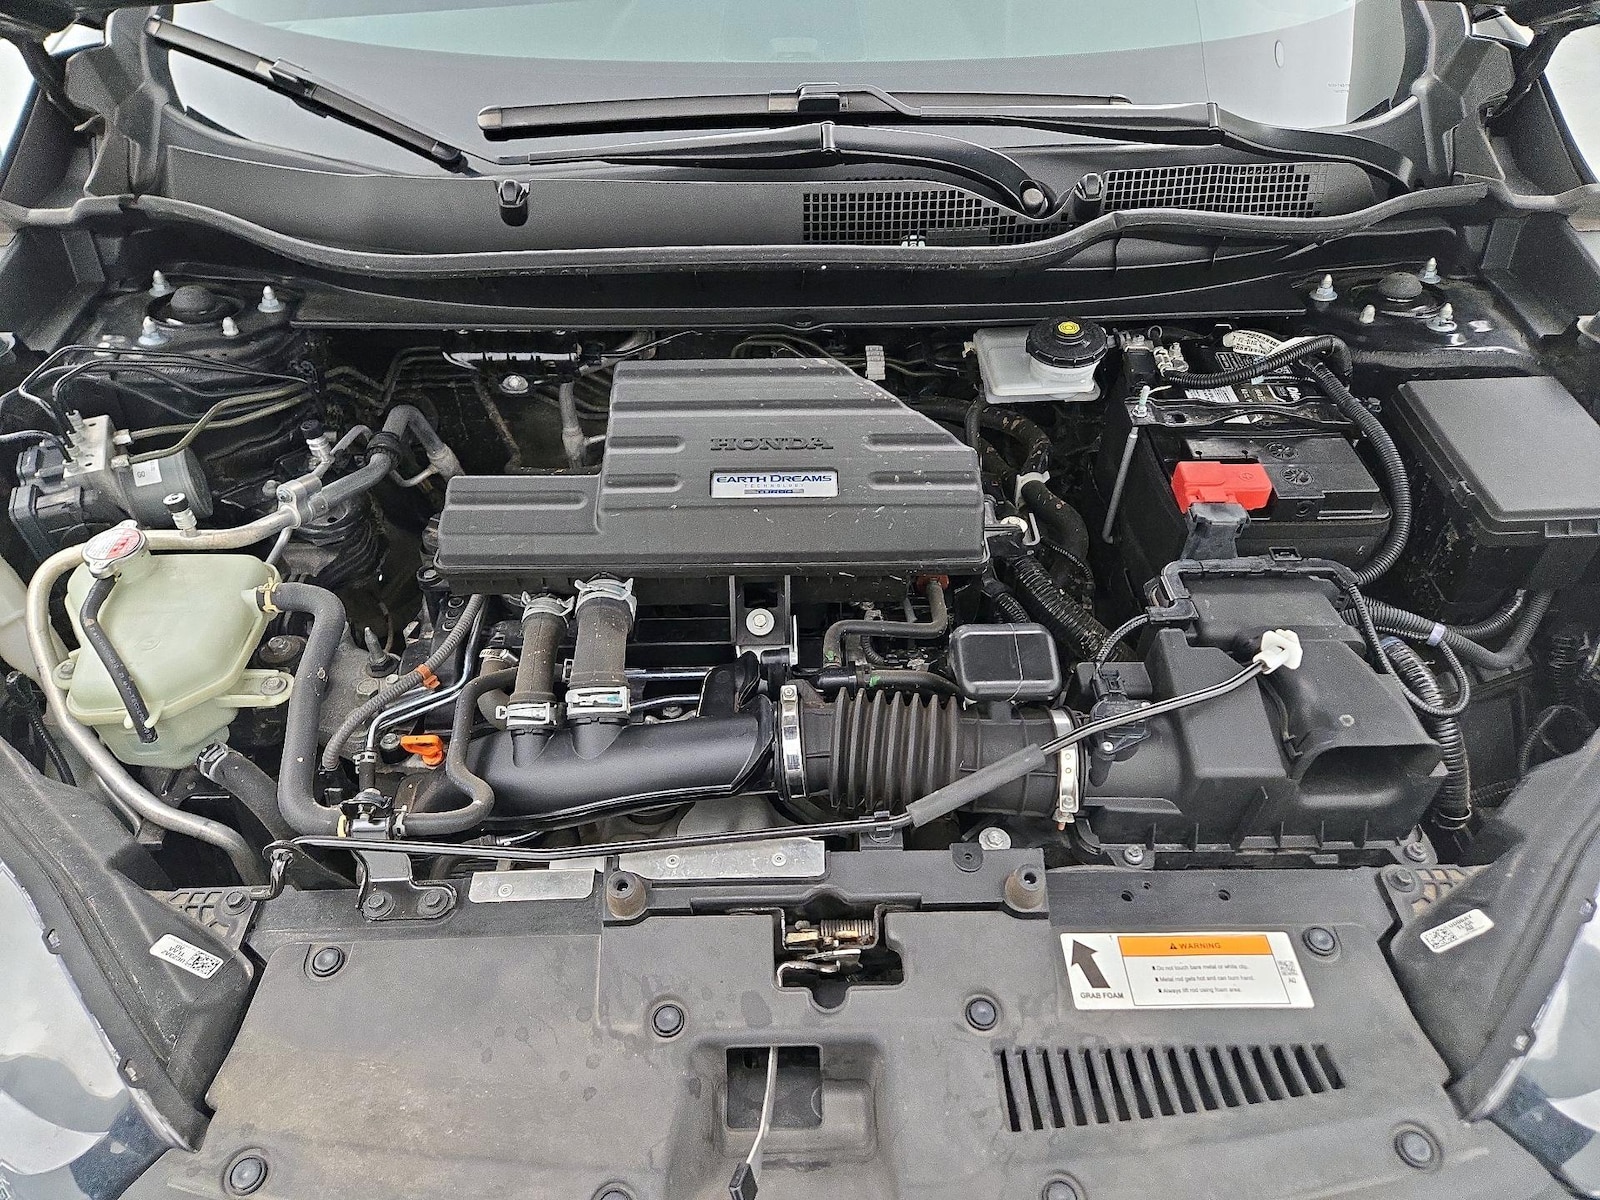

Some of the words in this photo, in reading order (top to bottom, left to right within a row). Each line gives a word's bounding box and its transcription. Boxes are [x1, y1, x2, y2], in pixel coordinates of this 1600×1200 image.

[710, 437, 834, 451] HONDA
[716, 475, 767, 483] EARTH
[769, 474, 832, 483] DREAMS
[1179, 942, 1221, 950] WARNING
[1080, 991, 1101, 999] GRAB
[1102, 991, 1124, 999] FOAM
